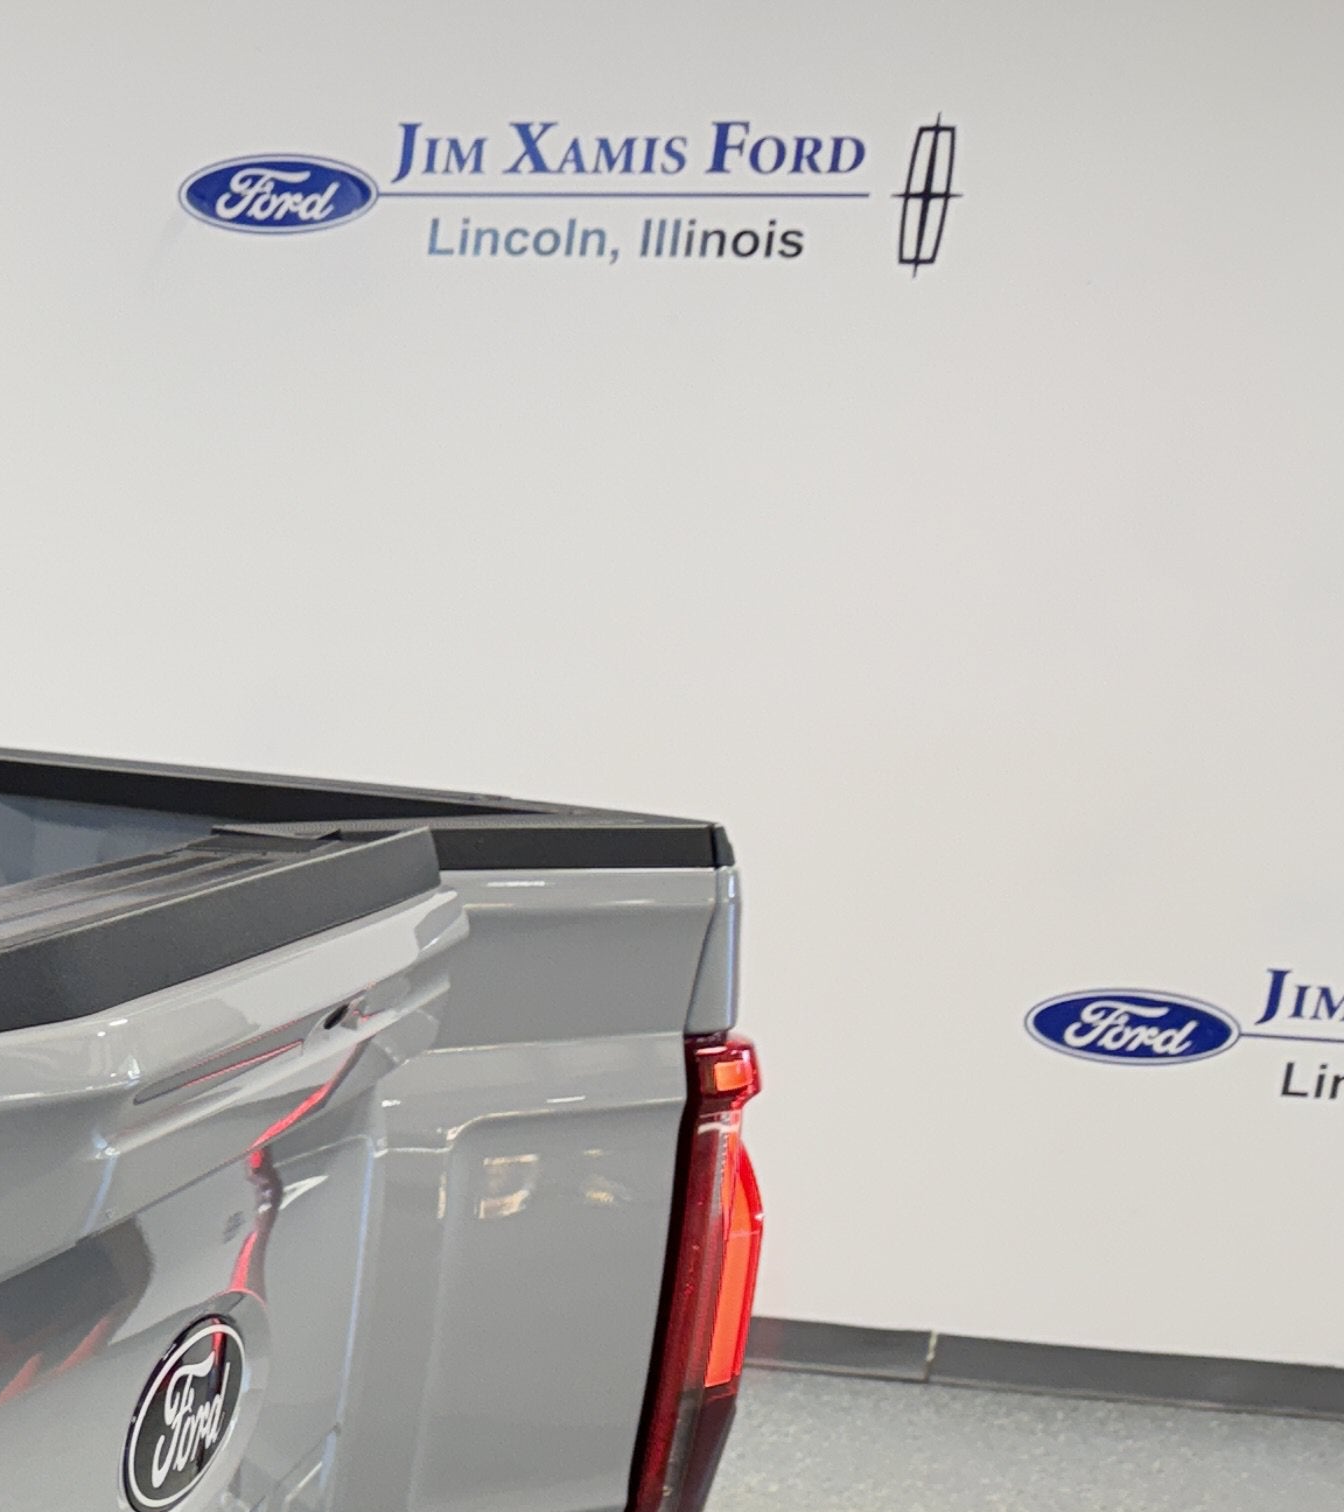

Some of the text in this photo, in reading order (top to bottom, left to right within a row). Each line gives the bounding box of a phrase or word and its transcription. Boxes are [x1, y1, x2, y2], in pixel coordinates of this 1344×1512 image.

[390, 120, 866, 184] JIM XAMIS FORD
[215, 167, 341, 221] Ford
[426, 216, 805, 265] Lincoln, Illinois
[1063, 999, 1199, 1055] Ford
[151, 1350, 231, 1488] Ford
